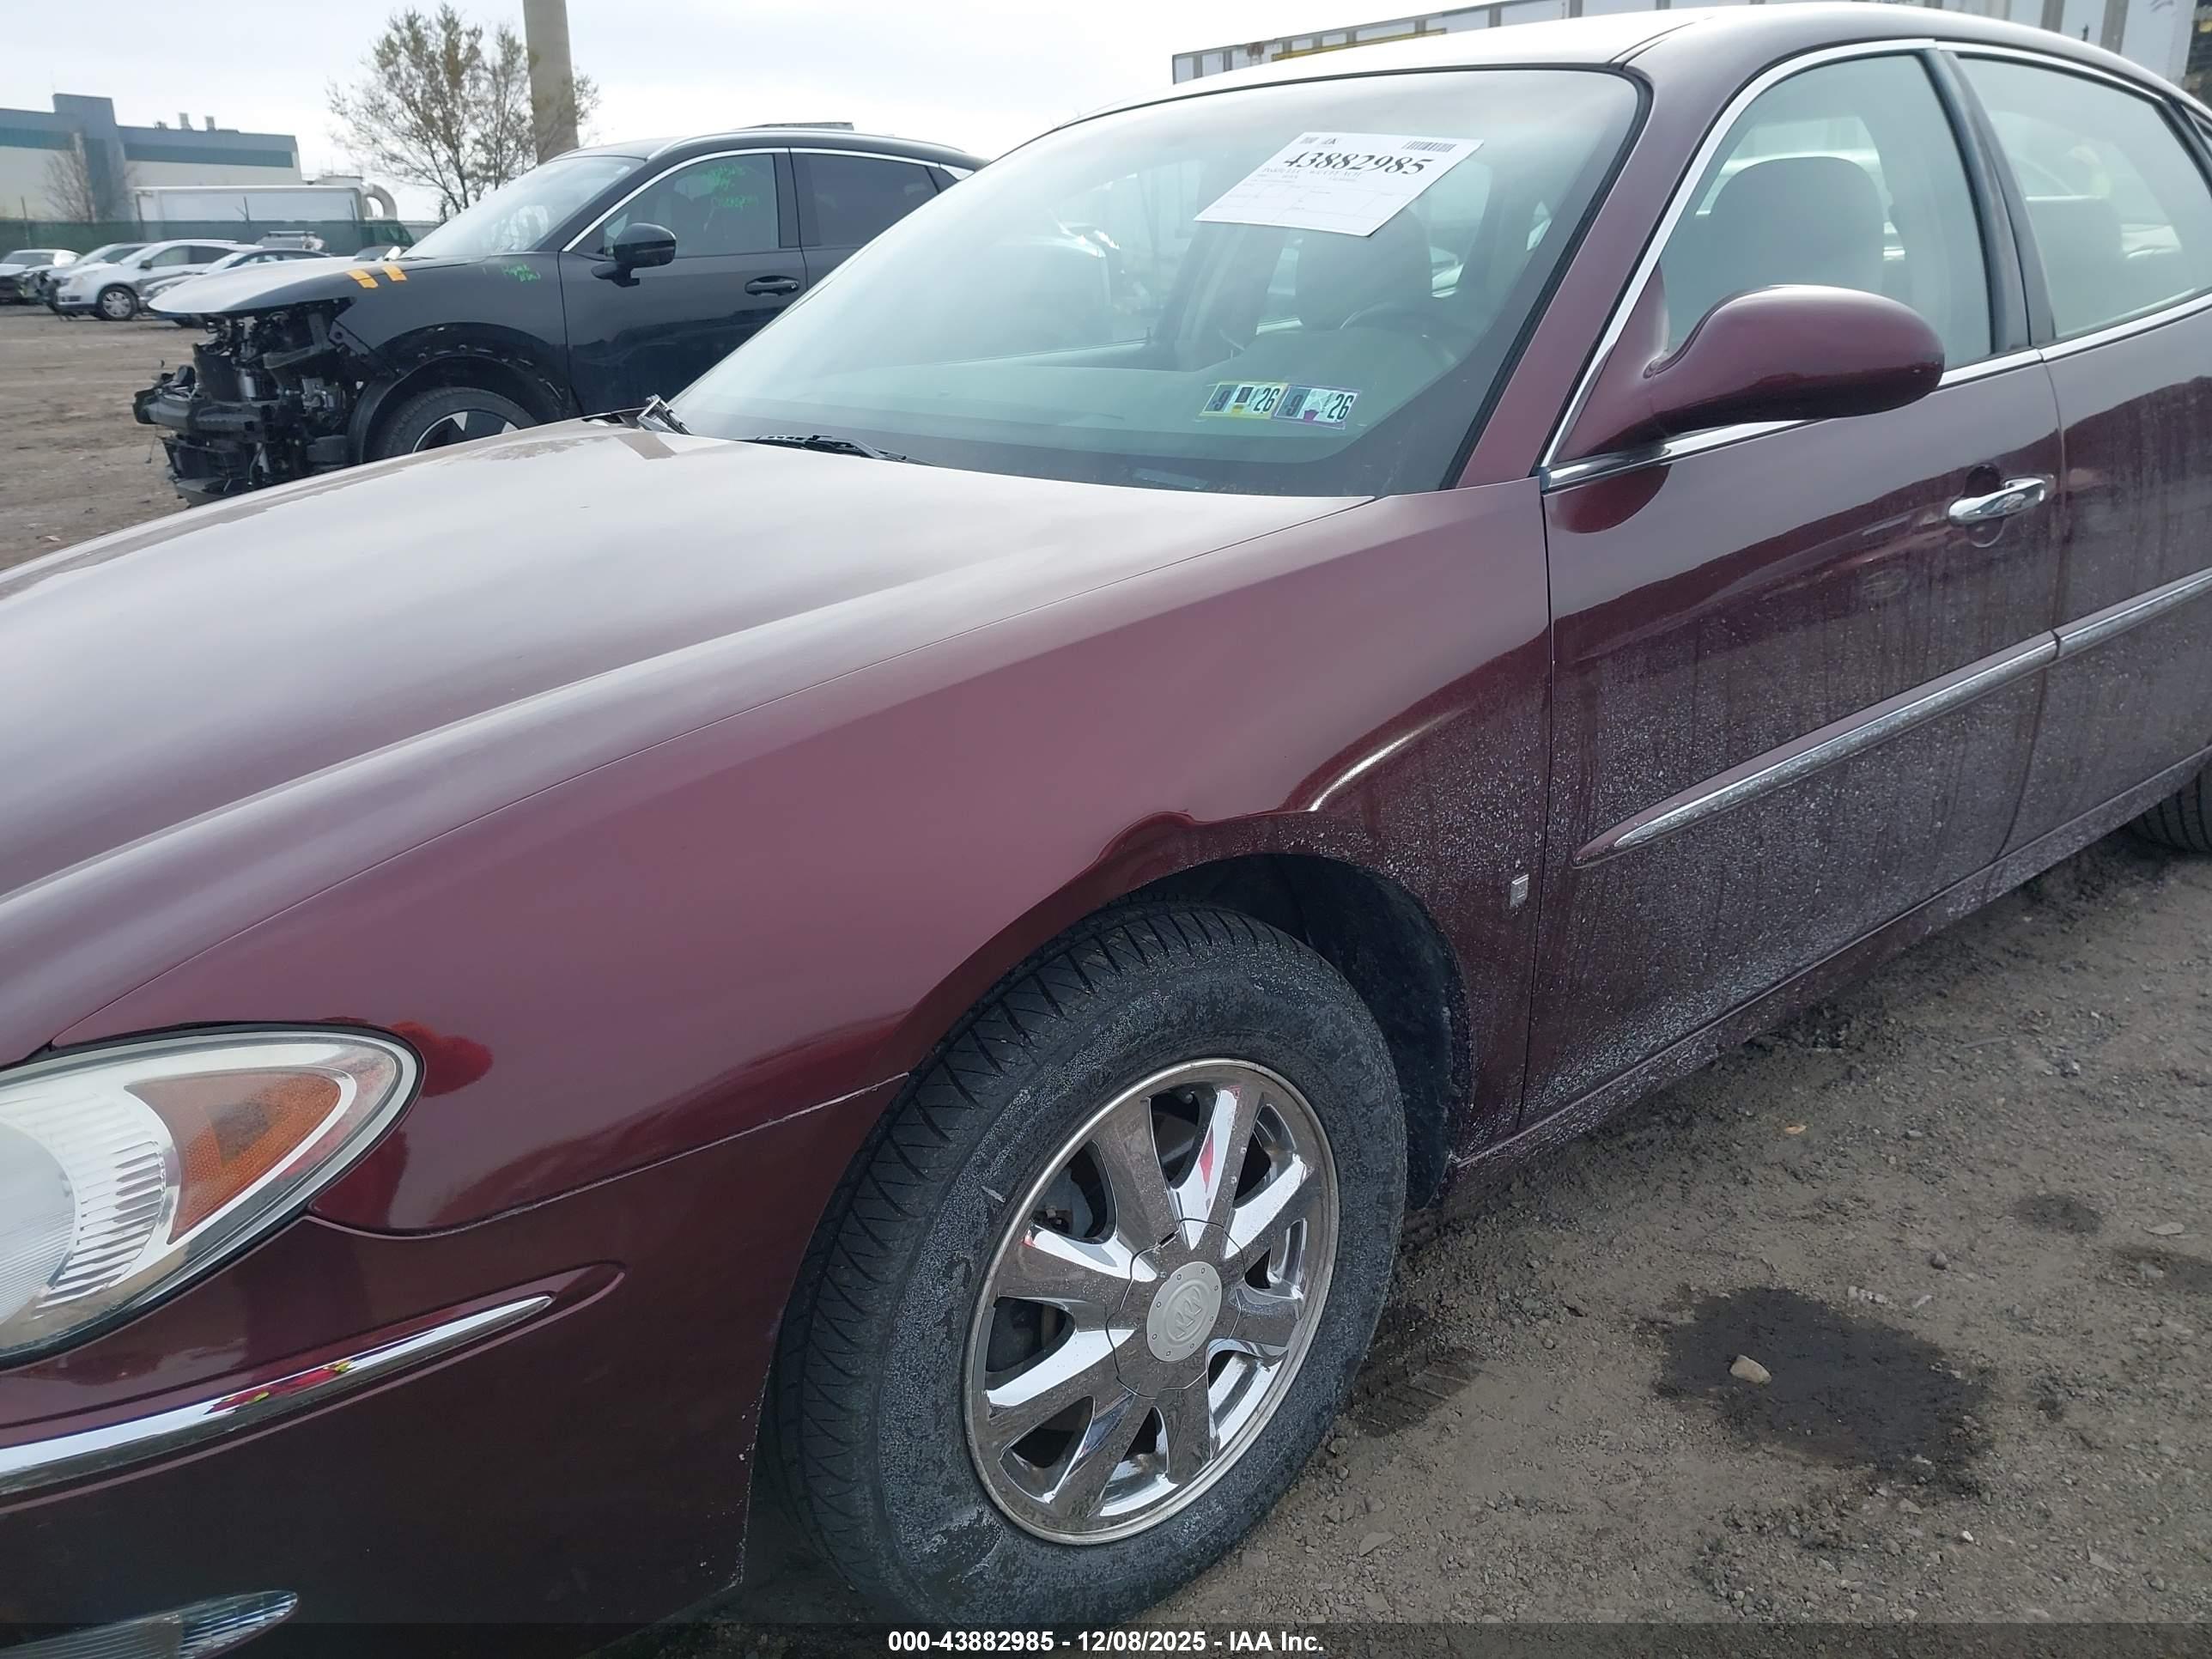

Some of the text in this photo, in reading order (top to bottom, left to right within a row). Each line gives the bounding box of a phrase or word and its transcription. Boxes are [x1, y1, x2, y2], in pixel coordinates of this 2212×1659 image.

[1285, 151, 1434, 174] 43882985
[1254, 387, 1280, 412] 26
[1286, 393, 1354, 420] 9 26
